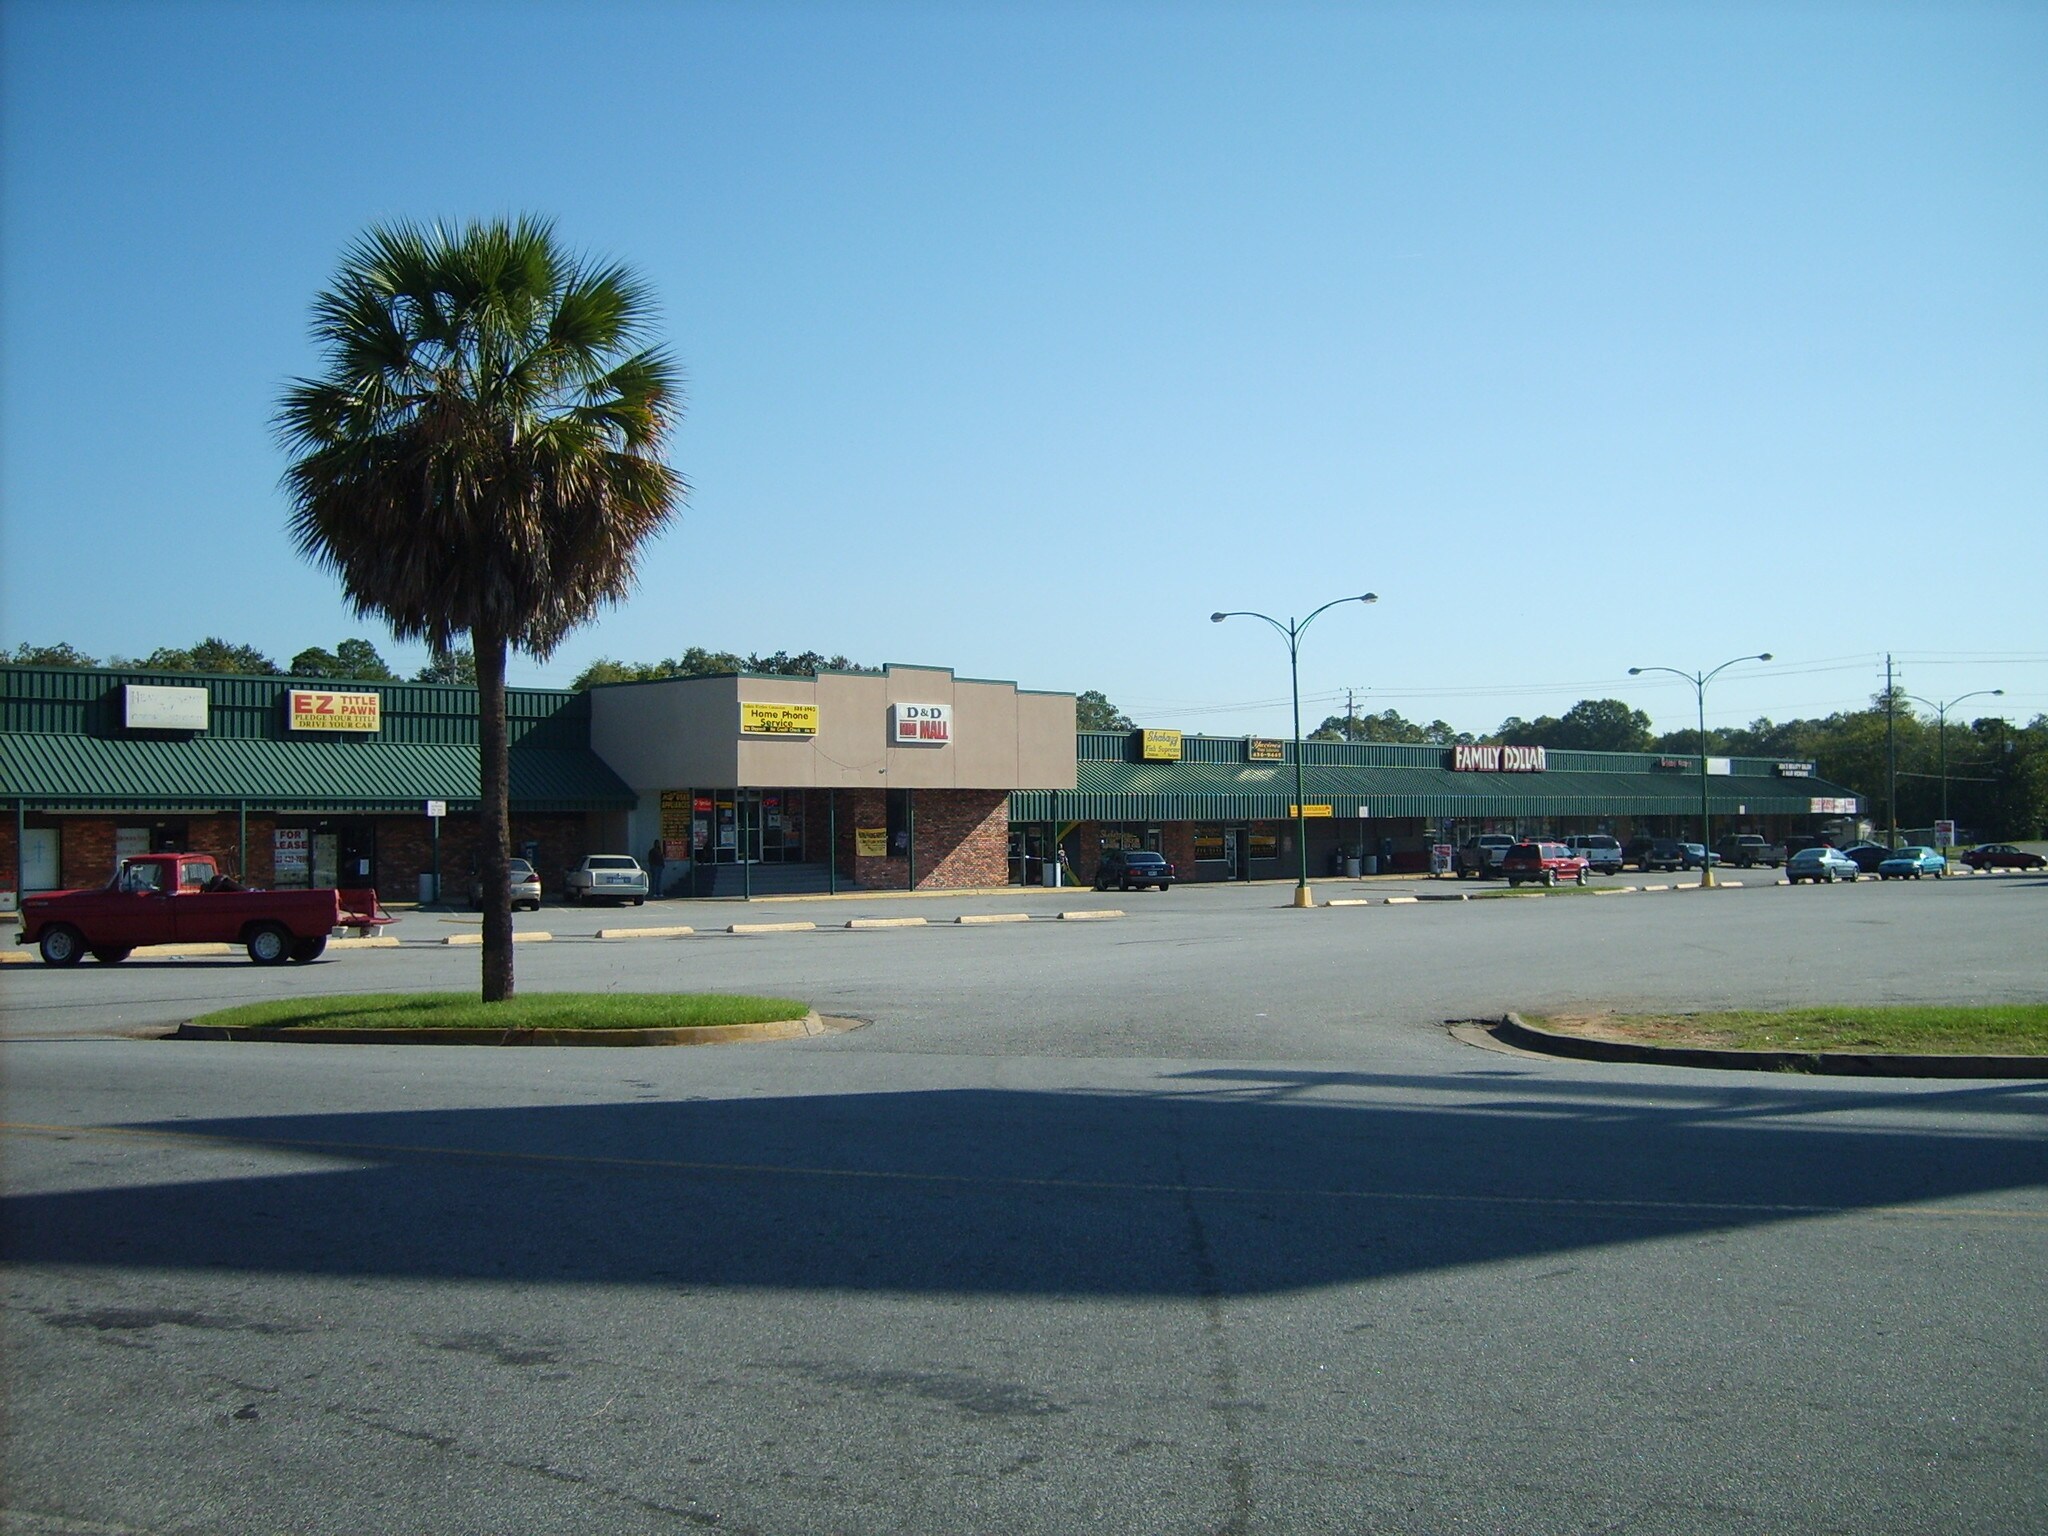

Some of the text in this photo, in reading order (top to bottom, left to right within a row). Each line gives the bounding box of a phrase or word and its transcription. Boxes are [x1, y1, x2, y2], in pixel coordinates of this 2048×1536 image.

[295, 695, 334, 714] EZ
[340, 696, 376, 706] TITLE
[341, 706, 376, 715] PAWN
[751, 710, 808, 720] Home Phone
[760, 719, 793, 727] Service
[920, 721, 948, 739] MALL
[1455, 745, 1546, 769] FAMILY DOLLAR
[280, 830, 302, 839] FOR
[274, 841, 308, 850] LEASE
